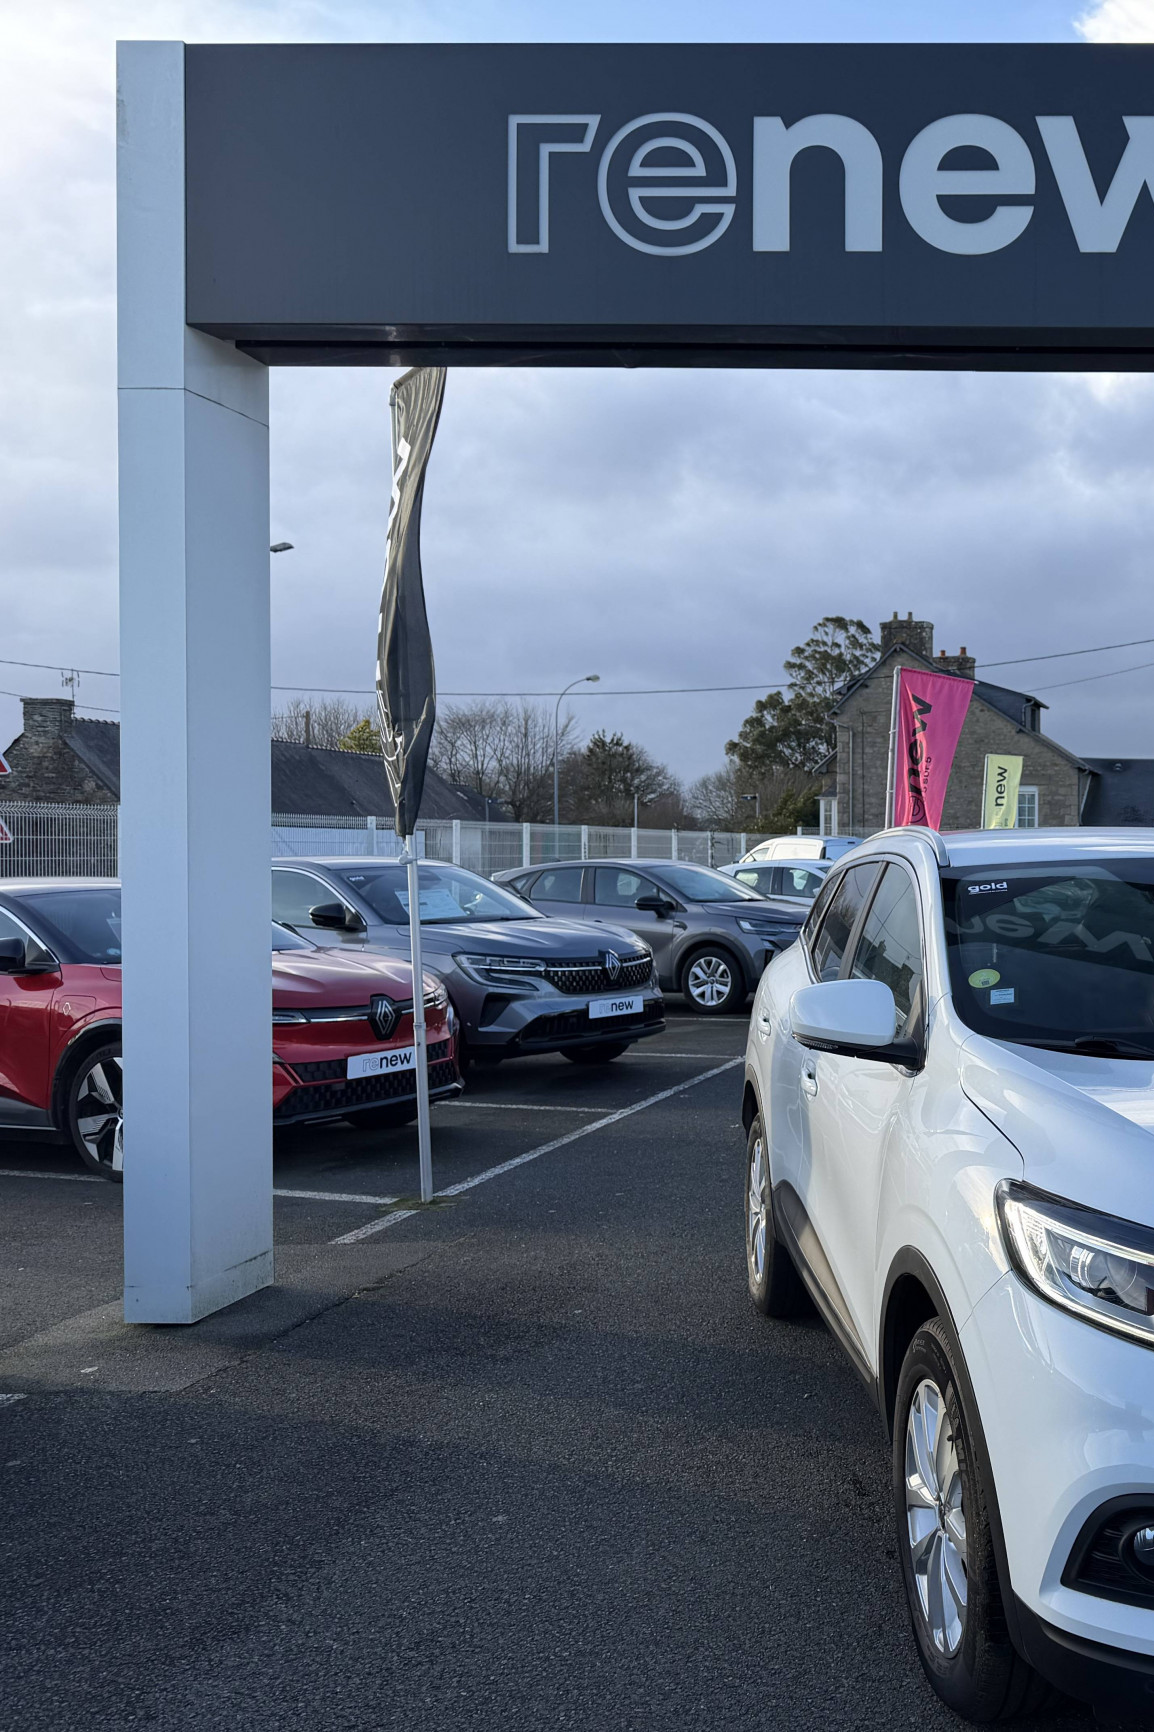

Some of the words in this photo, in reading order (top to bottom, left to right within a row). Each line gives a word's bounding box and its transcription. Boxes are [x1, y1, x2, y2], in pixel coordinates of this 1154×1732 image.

[908, 693, 933, 824] enew
[967, 881, 1008, 893] gold
[599, 1000, 634, 1015] renew
[362, 1051, 412, 1073] renew
